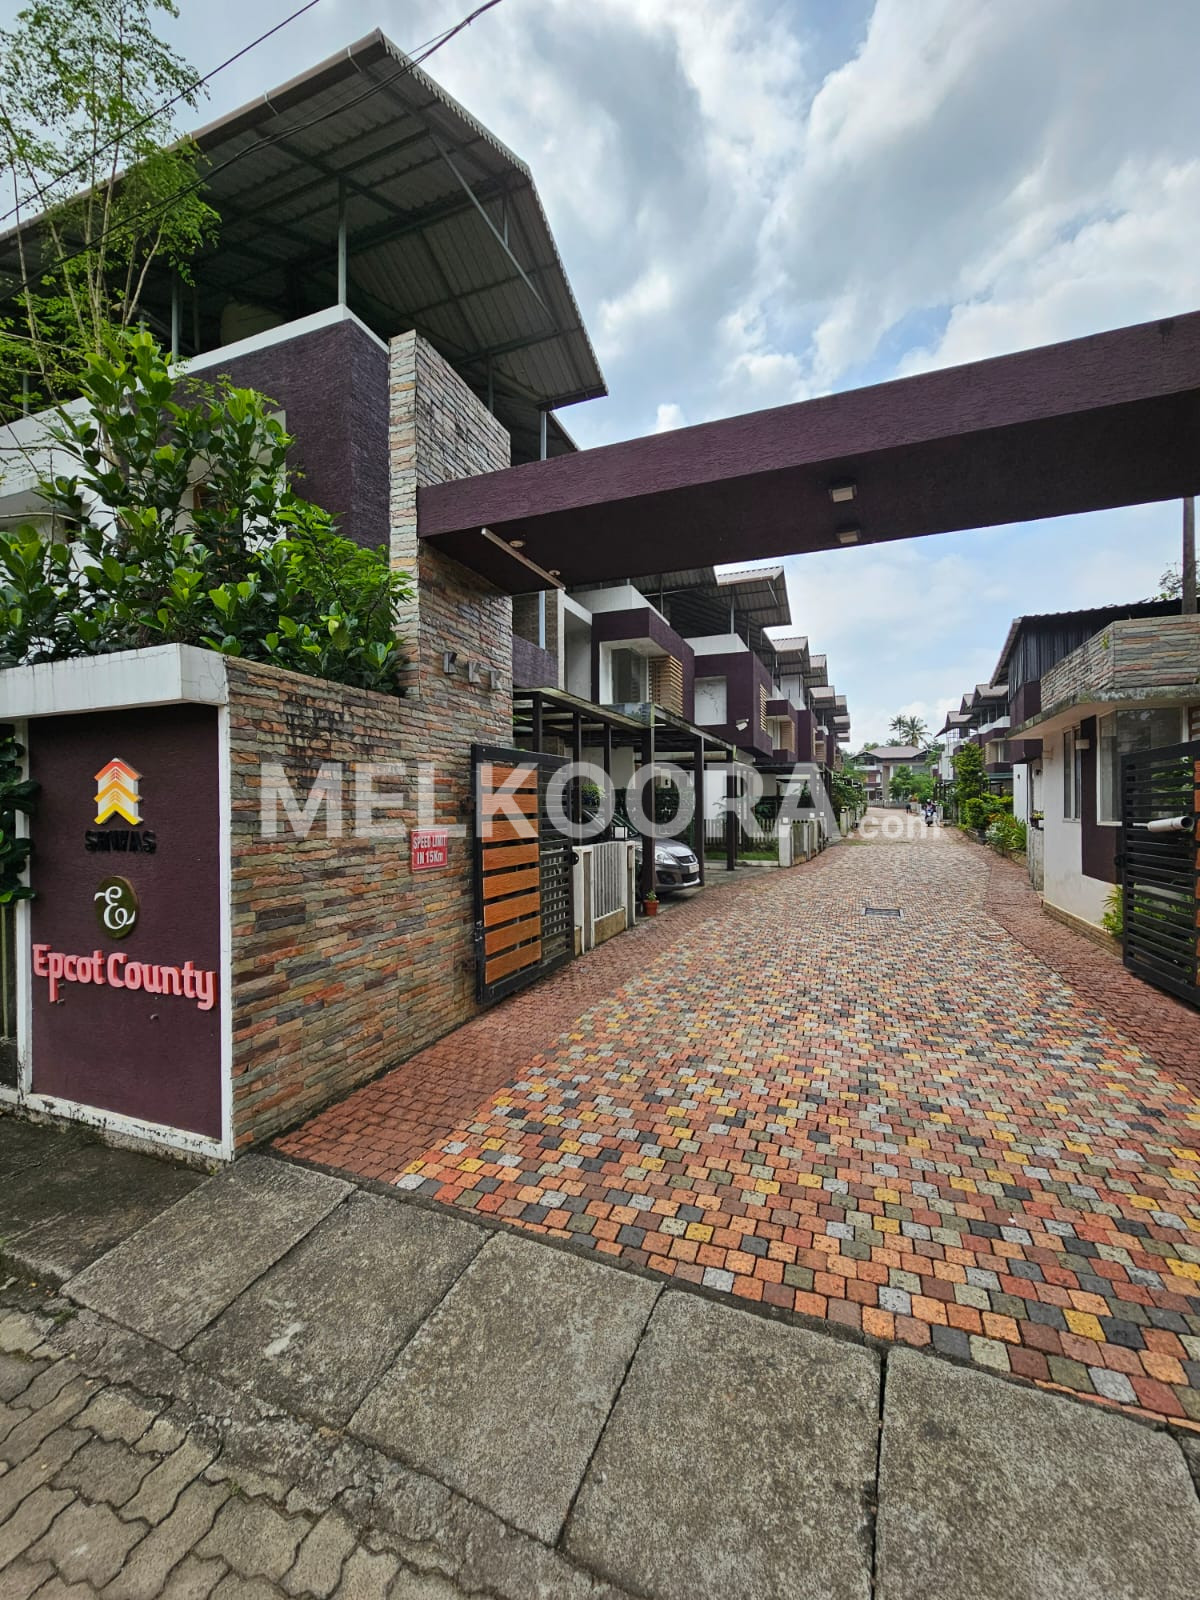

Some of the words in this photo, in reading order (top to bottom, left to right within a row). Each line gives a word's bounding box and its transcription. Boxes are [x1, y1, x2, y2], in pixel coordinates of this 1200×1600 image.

[417, 851, 425, 865] IN
[32, 944, 106, 1002] Epcot
[107, 952, 217, 1011] County
